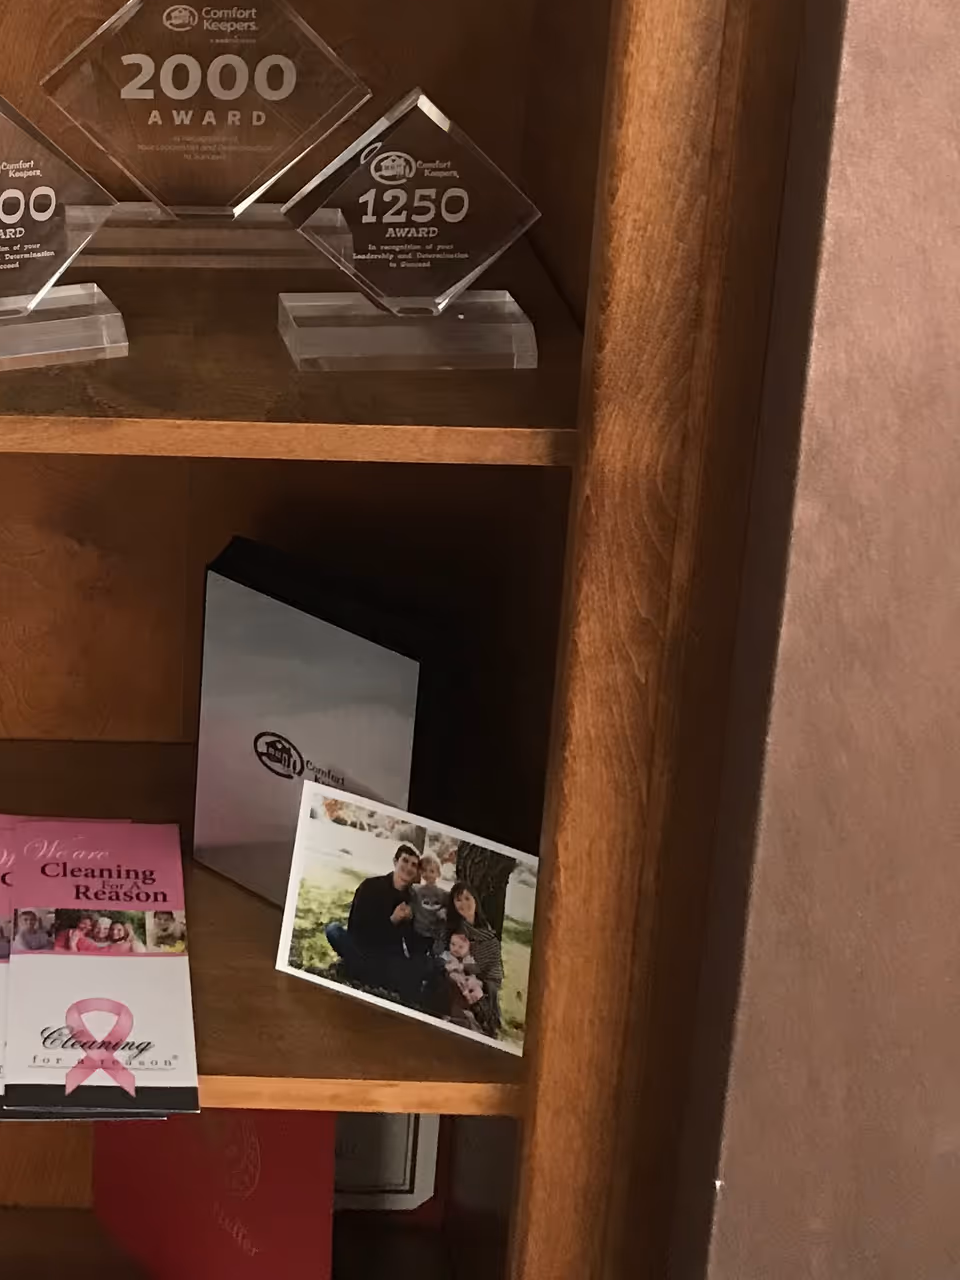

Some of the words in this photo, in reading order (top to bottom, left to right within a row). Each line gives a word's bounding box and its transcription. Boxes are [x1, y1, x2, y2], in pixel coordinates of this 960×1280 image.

[201, 6, 257, 19] Comfort
[120, 53, 297, 101] 2000
[148, 110, 266, 125] AWARD
[1, 160, 34, 171] Comfort
[416, 160, 451, 169] Comfort
[359, 188, 469, 223] 1250
[385, 227, 439, 238] AWARD
[23, 243, 41, 252] your
[4, 250, 55, 261] Determination
[305, 759, 346, 787] Comfort
[23, 839, 71, 861] We
[72, 850, 111, 861] are
[40, 861, 157, 886] Cleaning
[102, 880, 125, 890] For
[129, 880, 143, 890] A
[74, 884, 169, 903] Reason
[40, 1025, 156, 1062] Cleaning
[32, 1054, 63, 1064] for
[77, 1057, 85, 1065] a
